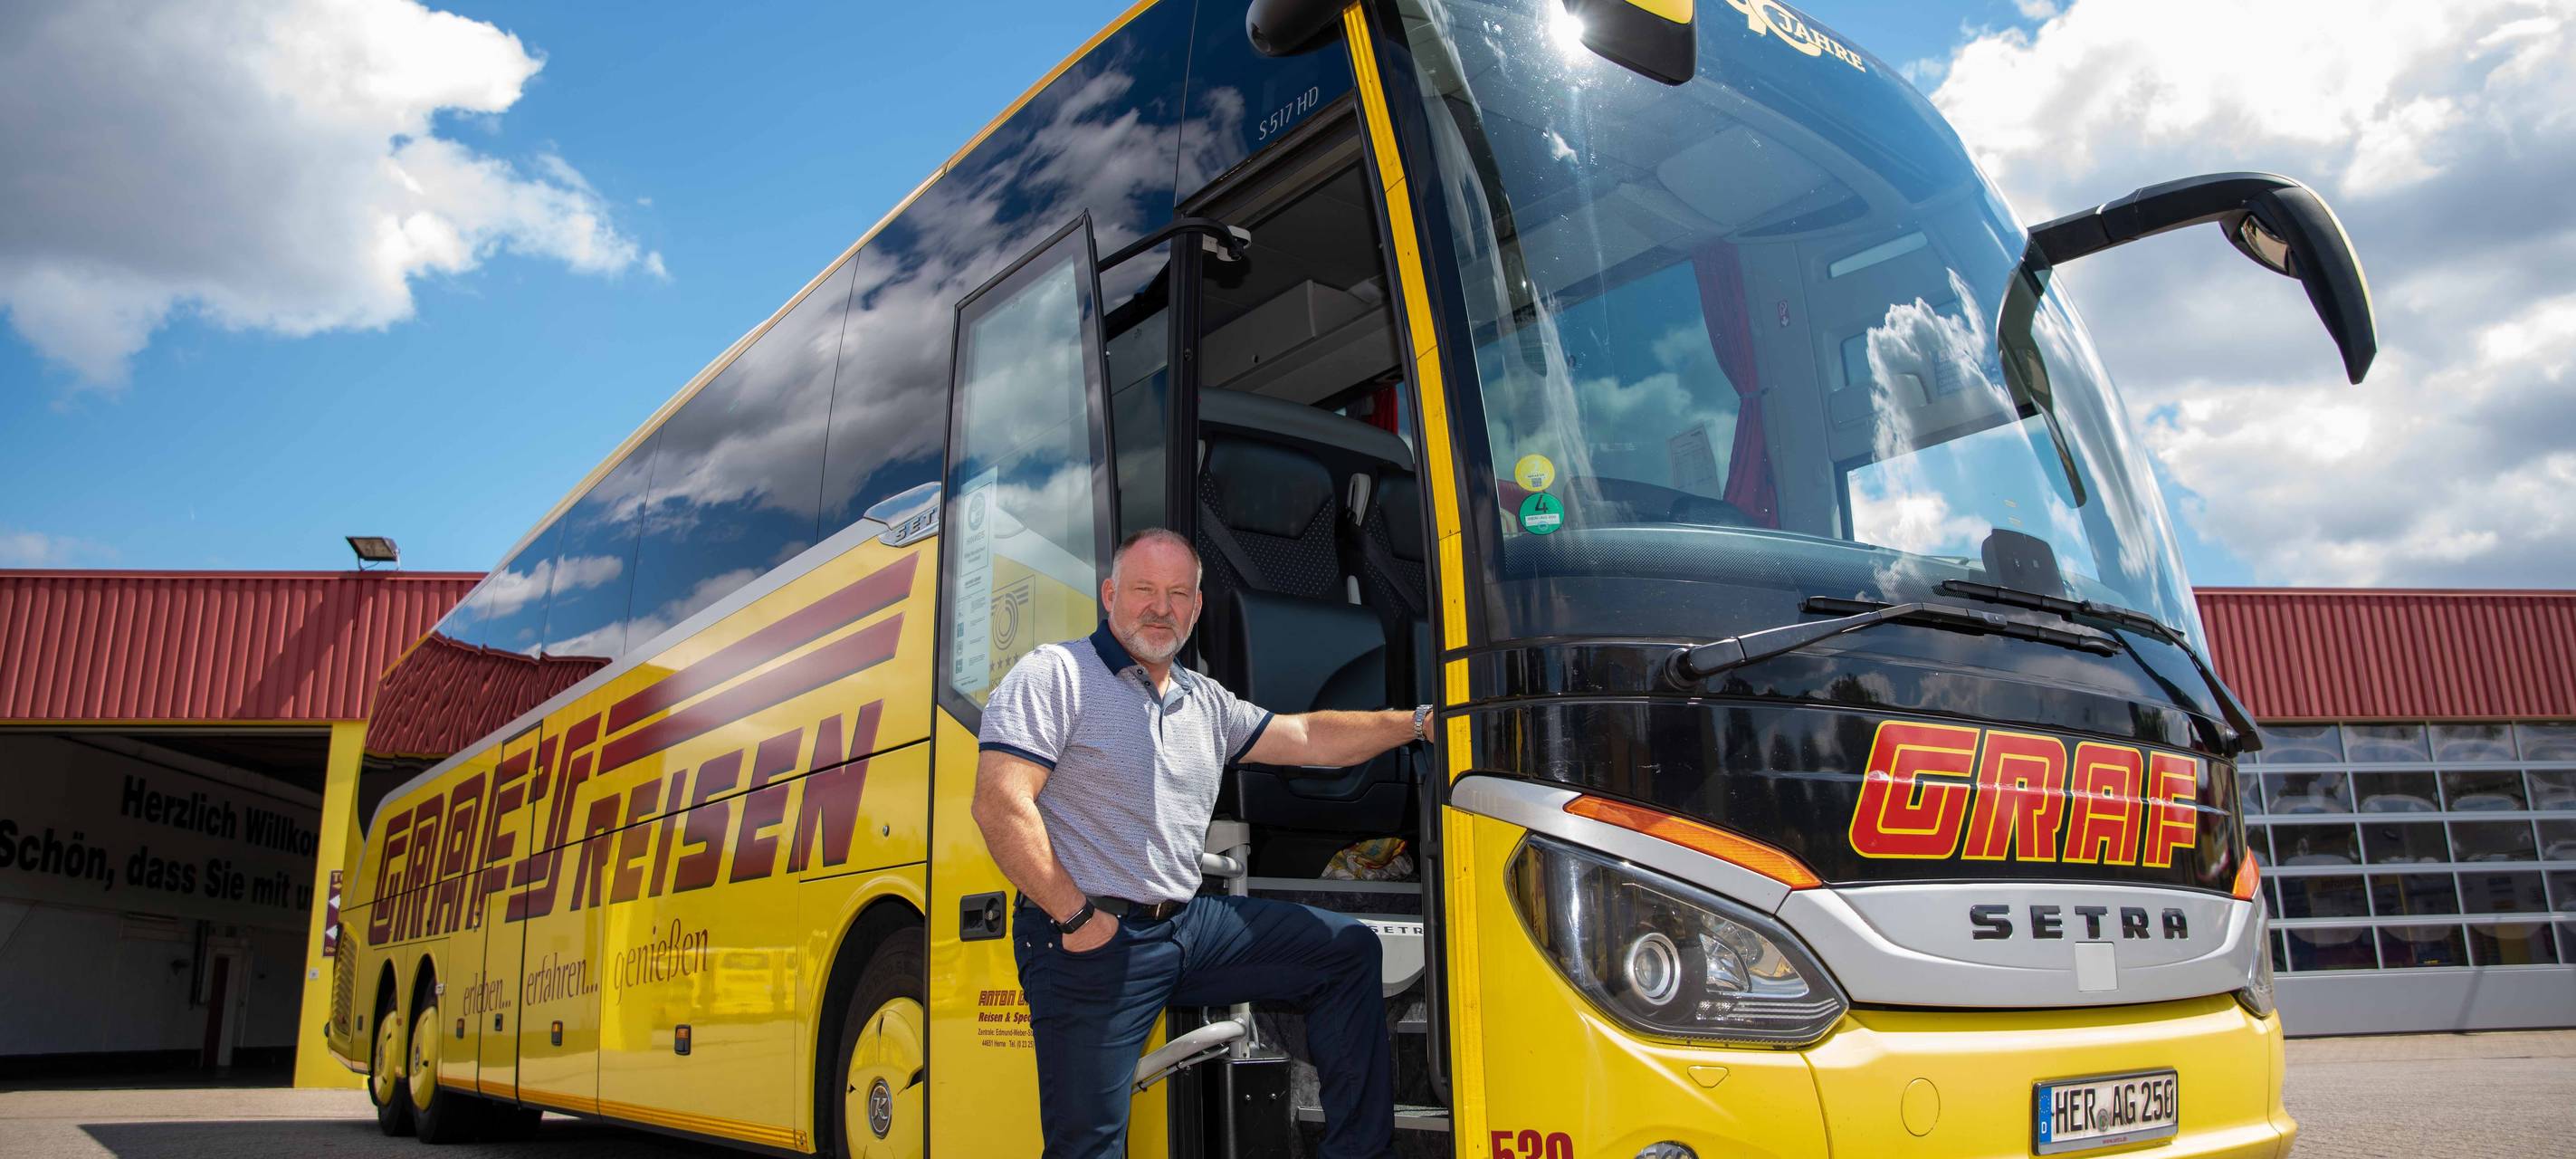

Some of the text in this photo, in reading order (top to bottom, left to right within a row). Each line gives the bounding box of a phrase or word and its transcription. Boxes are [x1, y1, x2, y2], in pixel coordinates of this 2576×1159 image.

[1778, 12, 1866, 73] JAHRE
[1258, 86, 1319, 141] S 517 HD
[1534, 494, 1549, 514] 4
[121, 774, 237, 840] Herzlich
[569, 698, 884, 912] REISEN
[1849, 720, 2198, 868] GRAF
[0, 819, 115, 892] Schön,
[127, 845, 196, 894] dass
[205, 857, 244, 900] Sie
[253, 871, 291, 907] mit
[1970, 904, 2189, 941] SETRA
[463, 917, 709, 1017] erleben... erfahren... genießen
[978, 1011, 1003, 1022] Reisen
[1005, 1011, 1011, 1022] &
[2041, 1121, 2047, 1134] D
[2055, 1087, 2096, 1134] HER
[2112, 1083, 2136, 1126] AG
